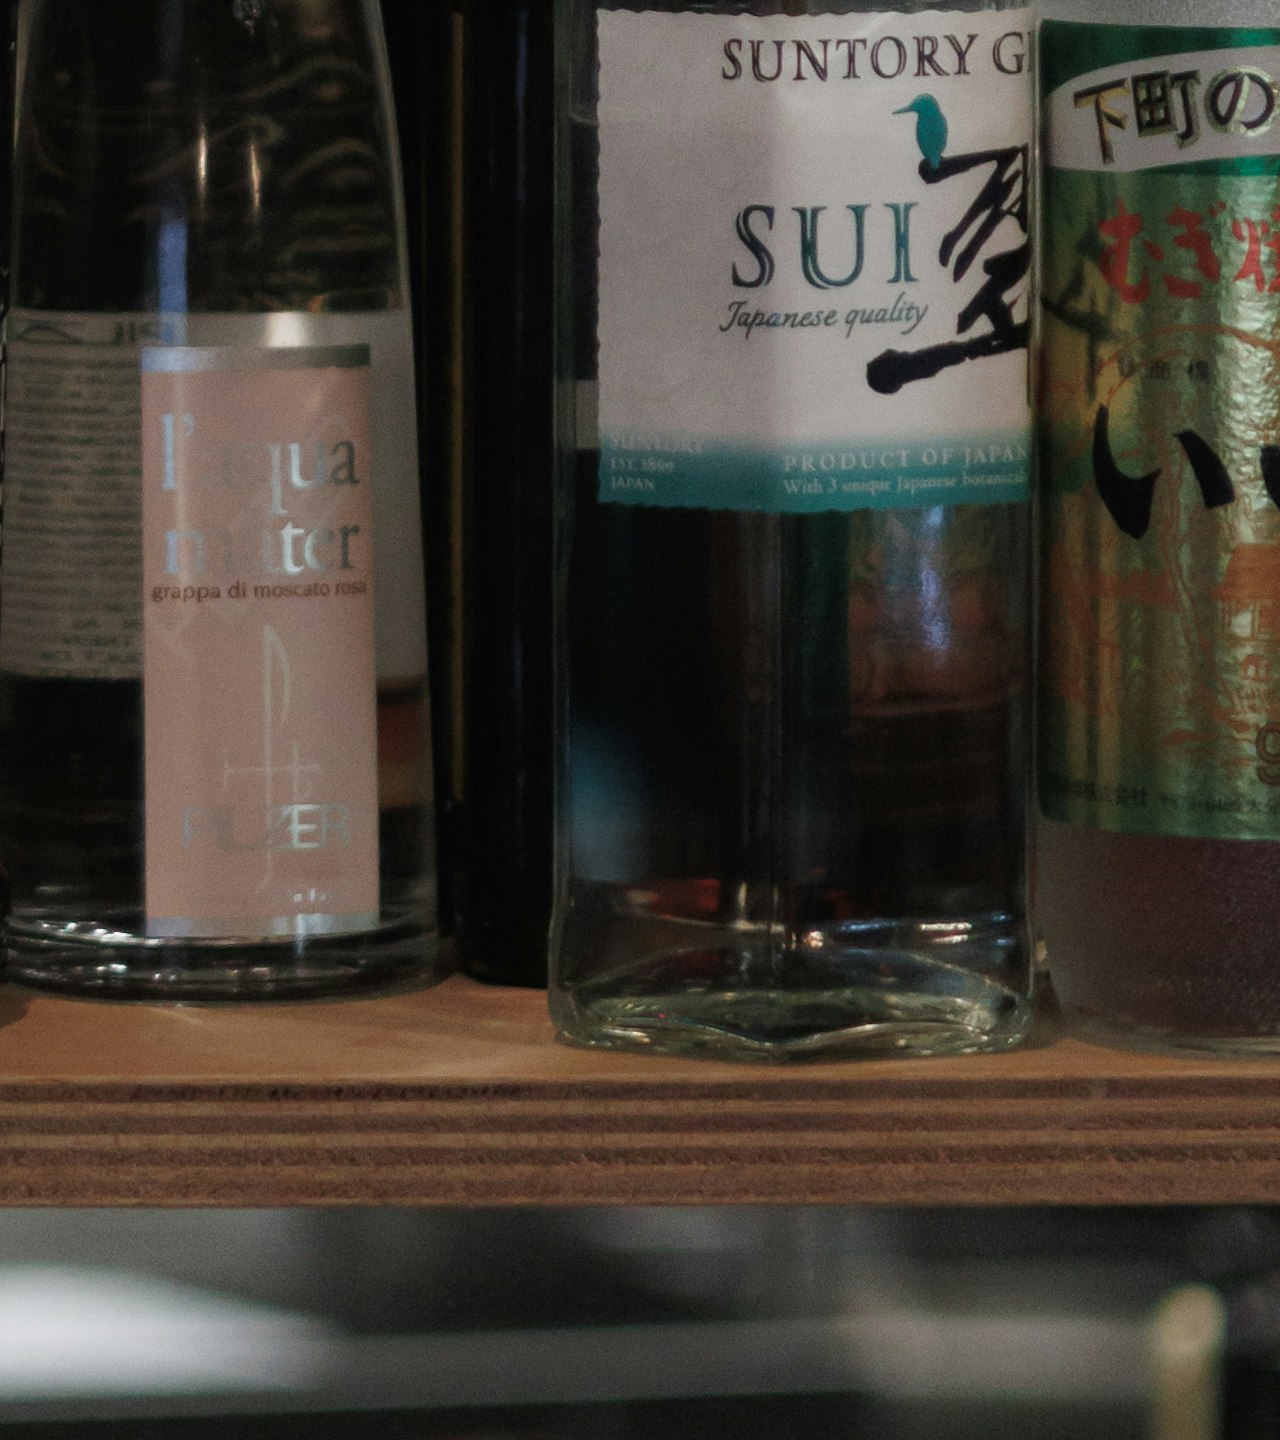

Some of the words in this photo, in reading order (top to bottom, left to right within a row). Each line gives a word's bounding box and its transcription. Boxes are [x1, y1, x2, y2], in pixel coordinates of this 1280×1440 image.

[722, 32, 979, 84] SUNTORY
[1072, 64, 1280, 165] 下町の
[730, 201, 920, 290] SUI
[719, 298, 839, 340] Japanese
[845, 290, 930, 339] quality
[783, 448, 909, 473] PRODUCT
[920, 447, 954, 467] OF
[610, 475, 657, 491] JAPAN
[783, 477, 823, 496] With
[826, 478, 838, 494] 3
[842, 477, 890, 496] unique
[896, 473, 957, 493] Japanese
[149, 581, 225, 606] grappa
[226, 578, 249, 601] di
[252, 579, 332, 600] moscato
[334, 577, 368, 597] rosa
